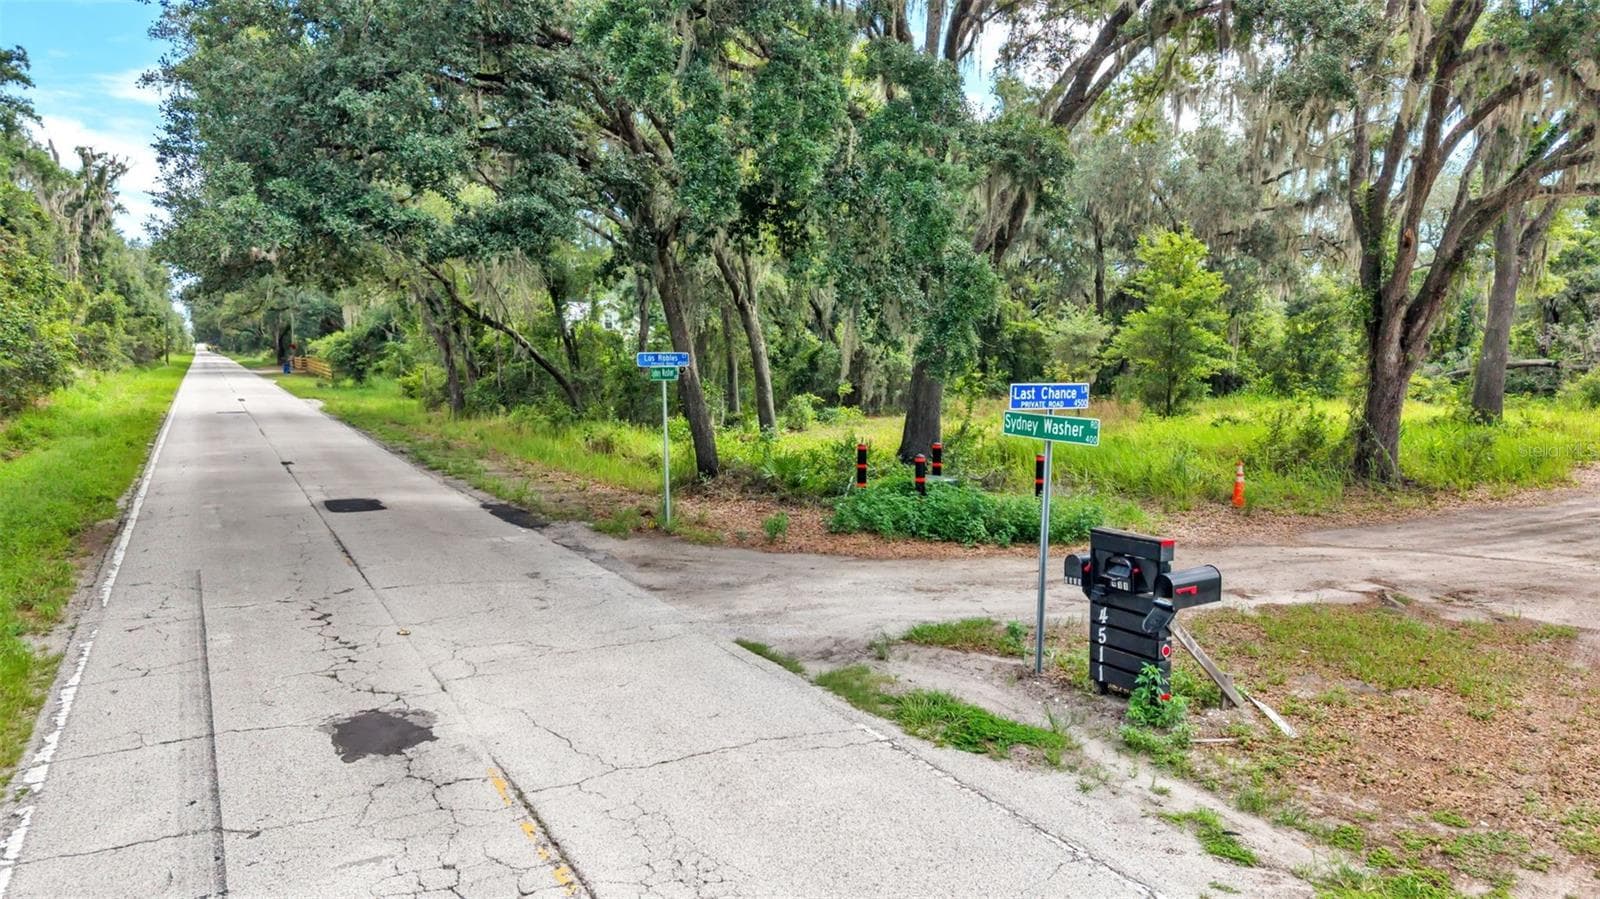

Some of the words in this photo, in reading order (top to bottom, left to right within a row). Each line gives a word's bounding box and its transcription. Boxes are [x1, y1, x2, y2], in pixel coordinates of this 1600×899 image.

[1013, 386, 1036, 400] Last
[1041, 386, 1077, 399] Chance
[1020, 400, 1045, 408] PRIVATE
[1048, 400, 1065, 408] ROAD
[1073, 399, 1088, 407] 4500
[1005, 413, 1039, 436] Sydney
[1043, 418, 1085, 437] Washer
[1085, 435, 1097, 444] 400
[1098, 606, 1109, 682] 4511
